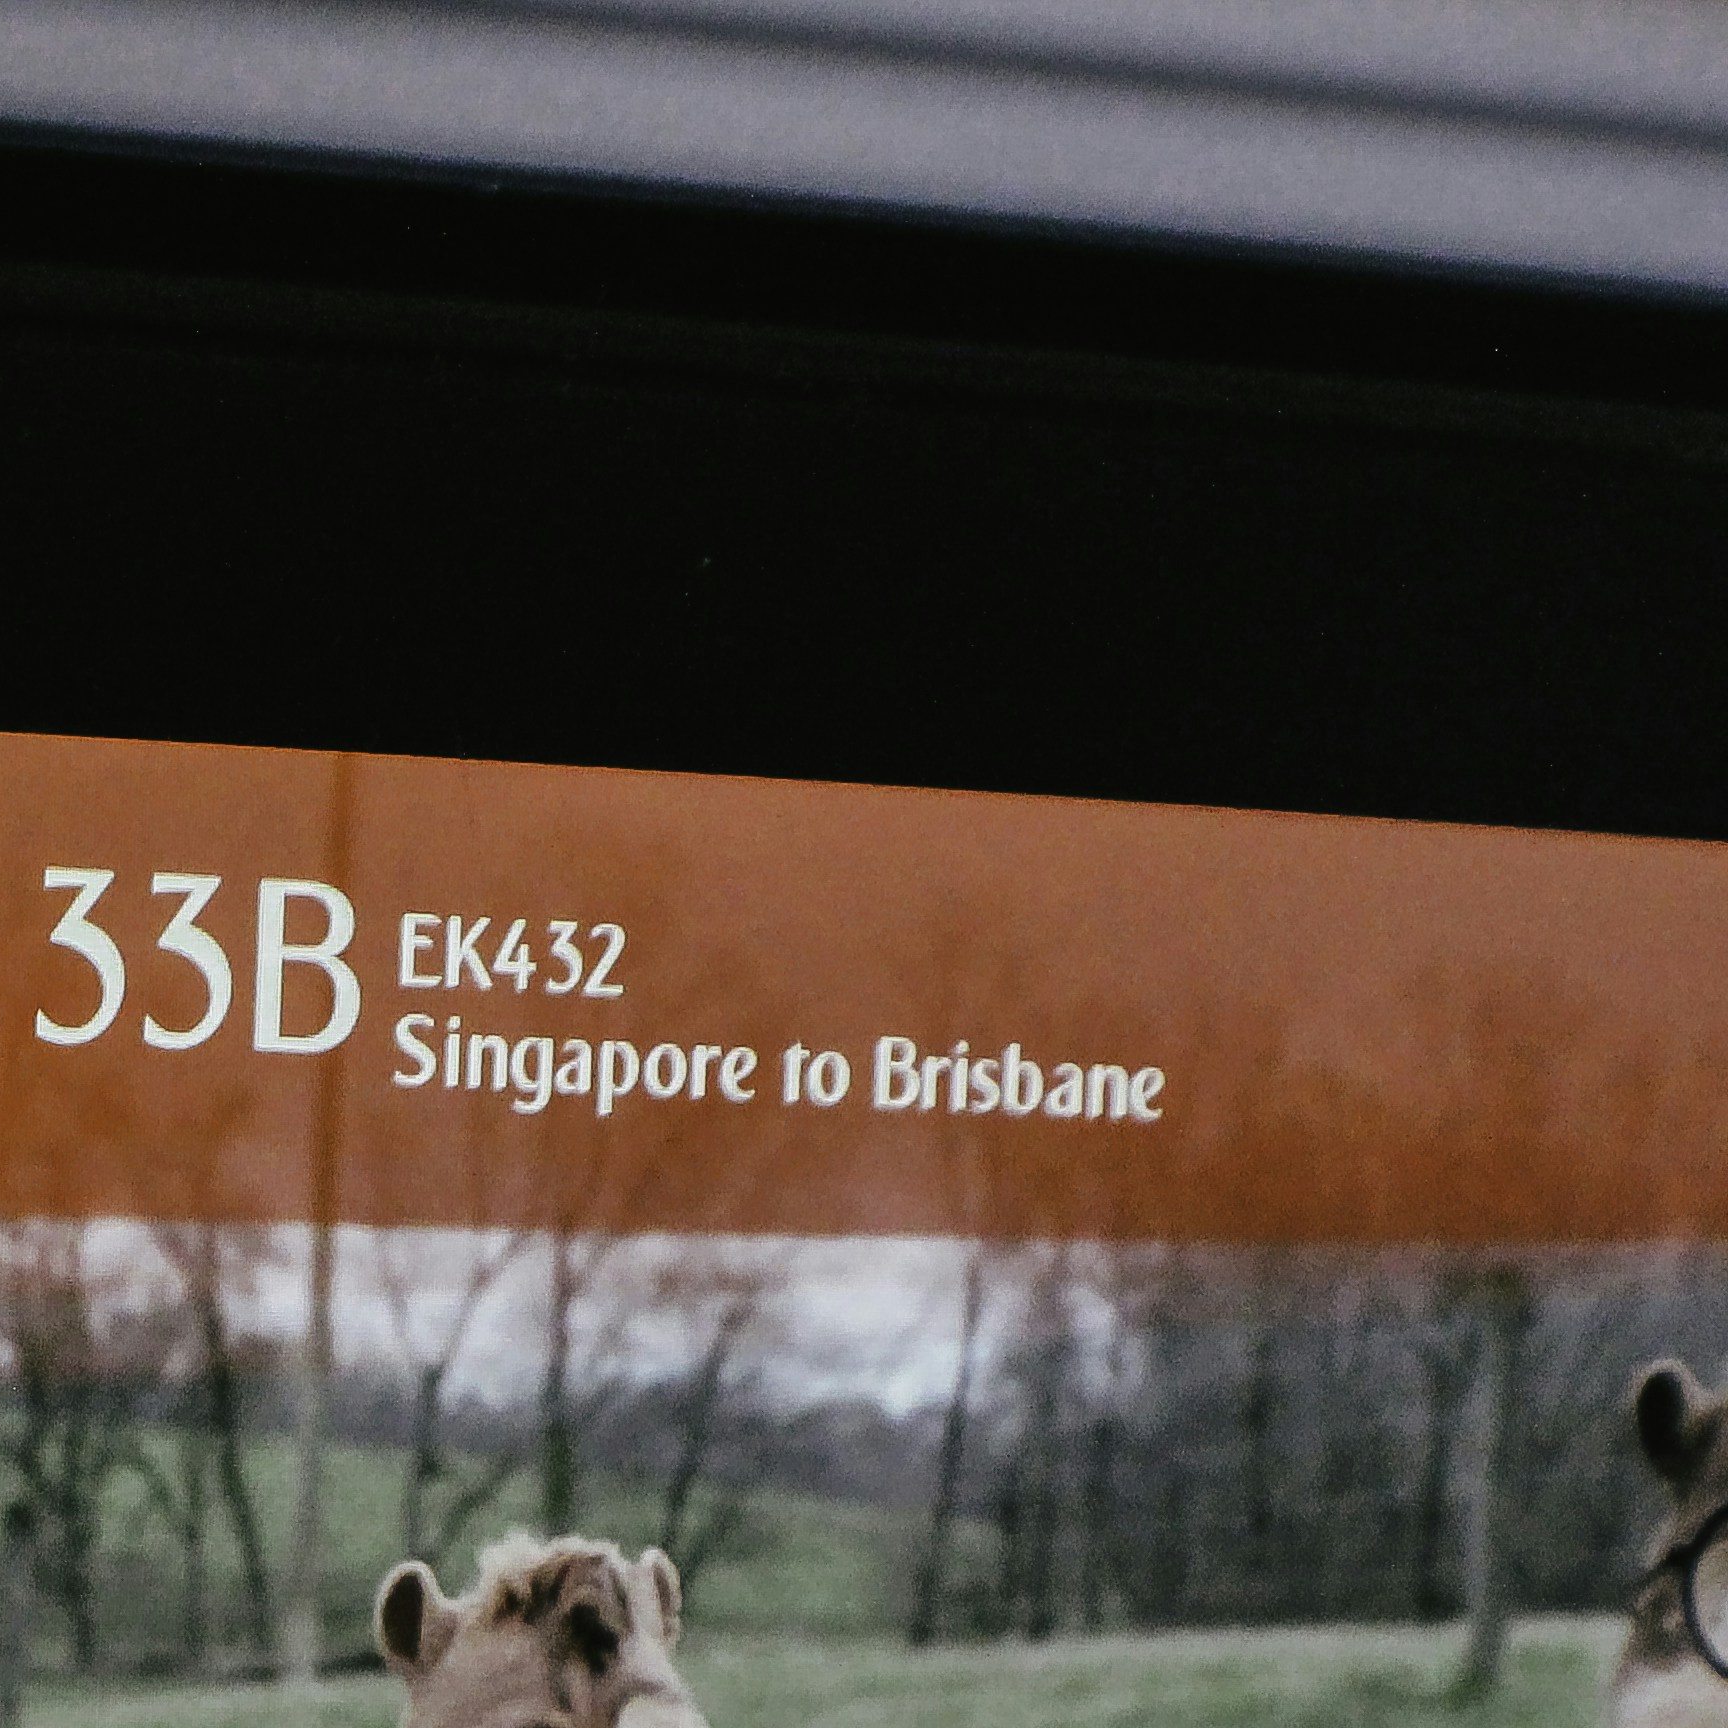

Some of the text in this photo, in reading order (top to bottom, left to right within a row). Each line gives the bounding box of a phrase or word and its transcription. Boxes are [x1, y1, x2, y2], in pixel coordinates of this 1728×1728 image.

[34, 865, 362, 1054] 33B
[398, 911, 626, 998] EK432
[393, 1012, 1166, 1121] Singapore to Brisbane
